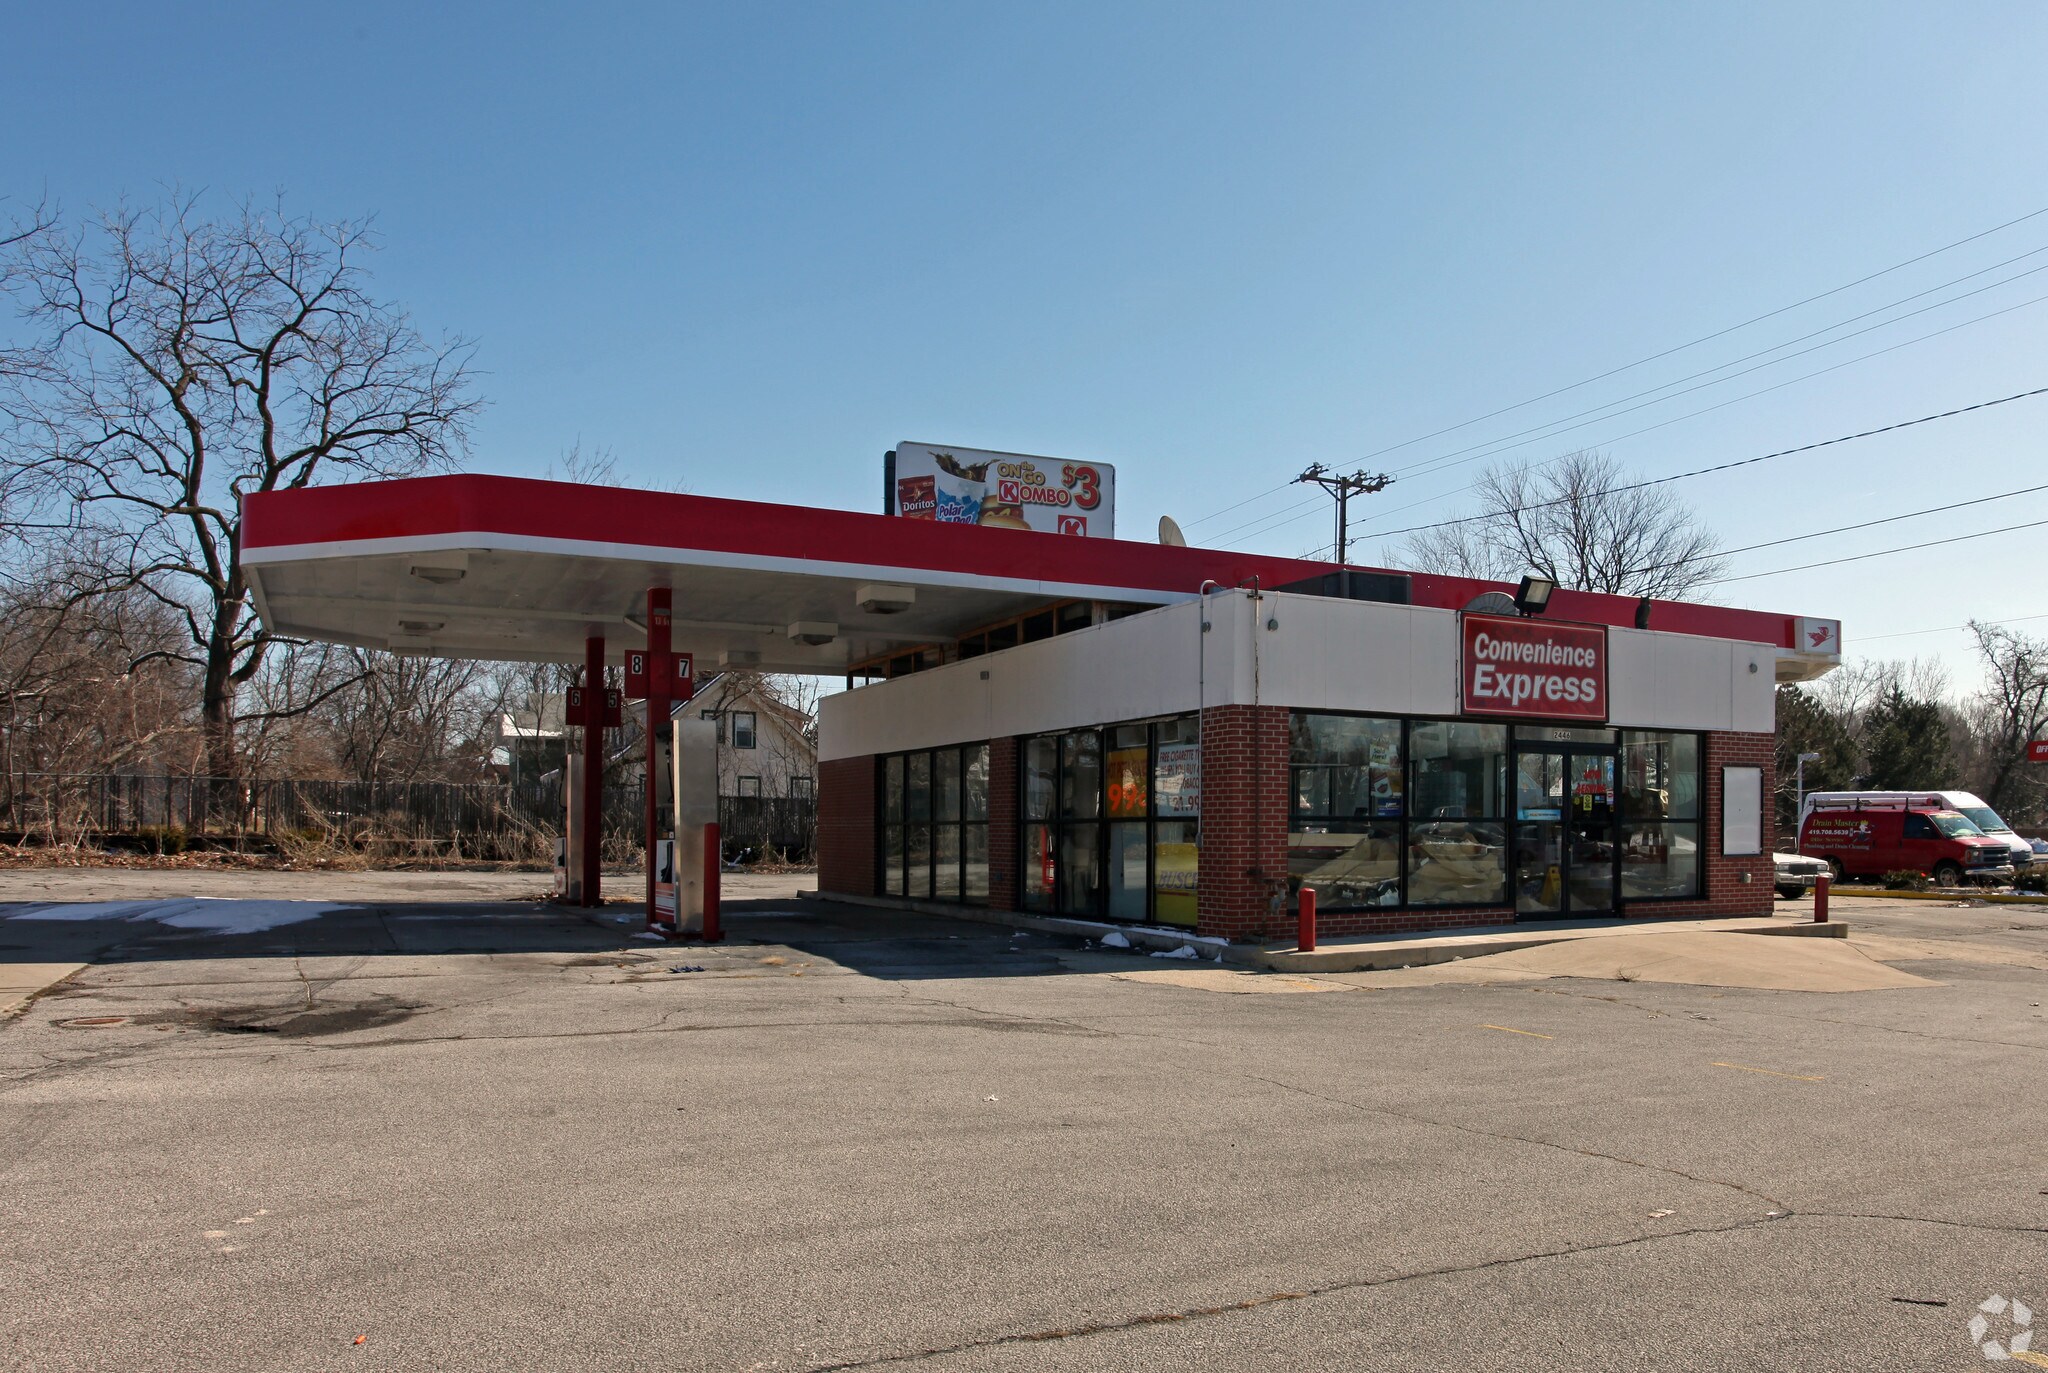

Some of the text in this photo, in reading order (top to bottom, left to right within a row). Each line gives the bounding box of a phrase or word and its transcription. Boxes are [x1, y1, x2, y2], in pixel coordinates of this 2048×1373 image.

[997, 461, 1045, 486] ON the GO
[999, 480, 1070, 506] KOMBO
[1061, 463, 1099, 508] $3
[903, 500, 935, 512] Doritos
[939, 503, 965, 518] Polar
[1474, 632, 1596, 668] Convenience
[633, 656, 641, 673] 8
[680, 660, 688, 676] 7
[1473, 663, 1597, 706] Express
[572, 692, 580, 705] 6
[609, 693, 617, 707] 5
[1159, 751, 1170, 762] FREE
[1170, 749, 1194, 762] CIGARETTE
